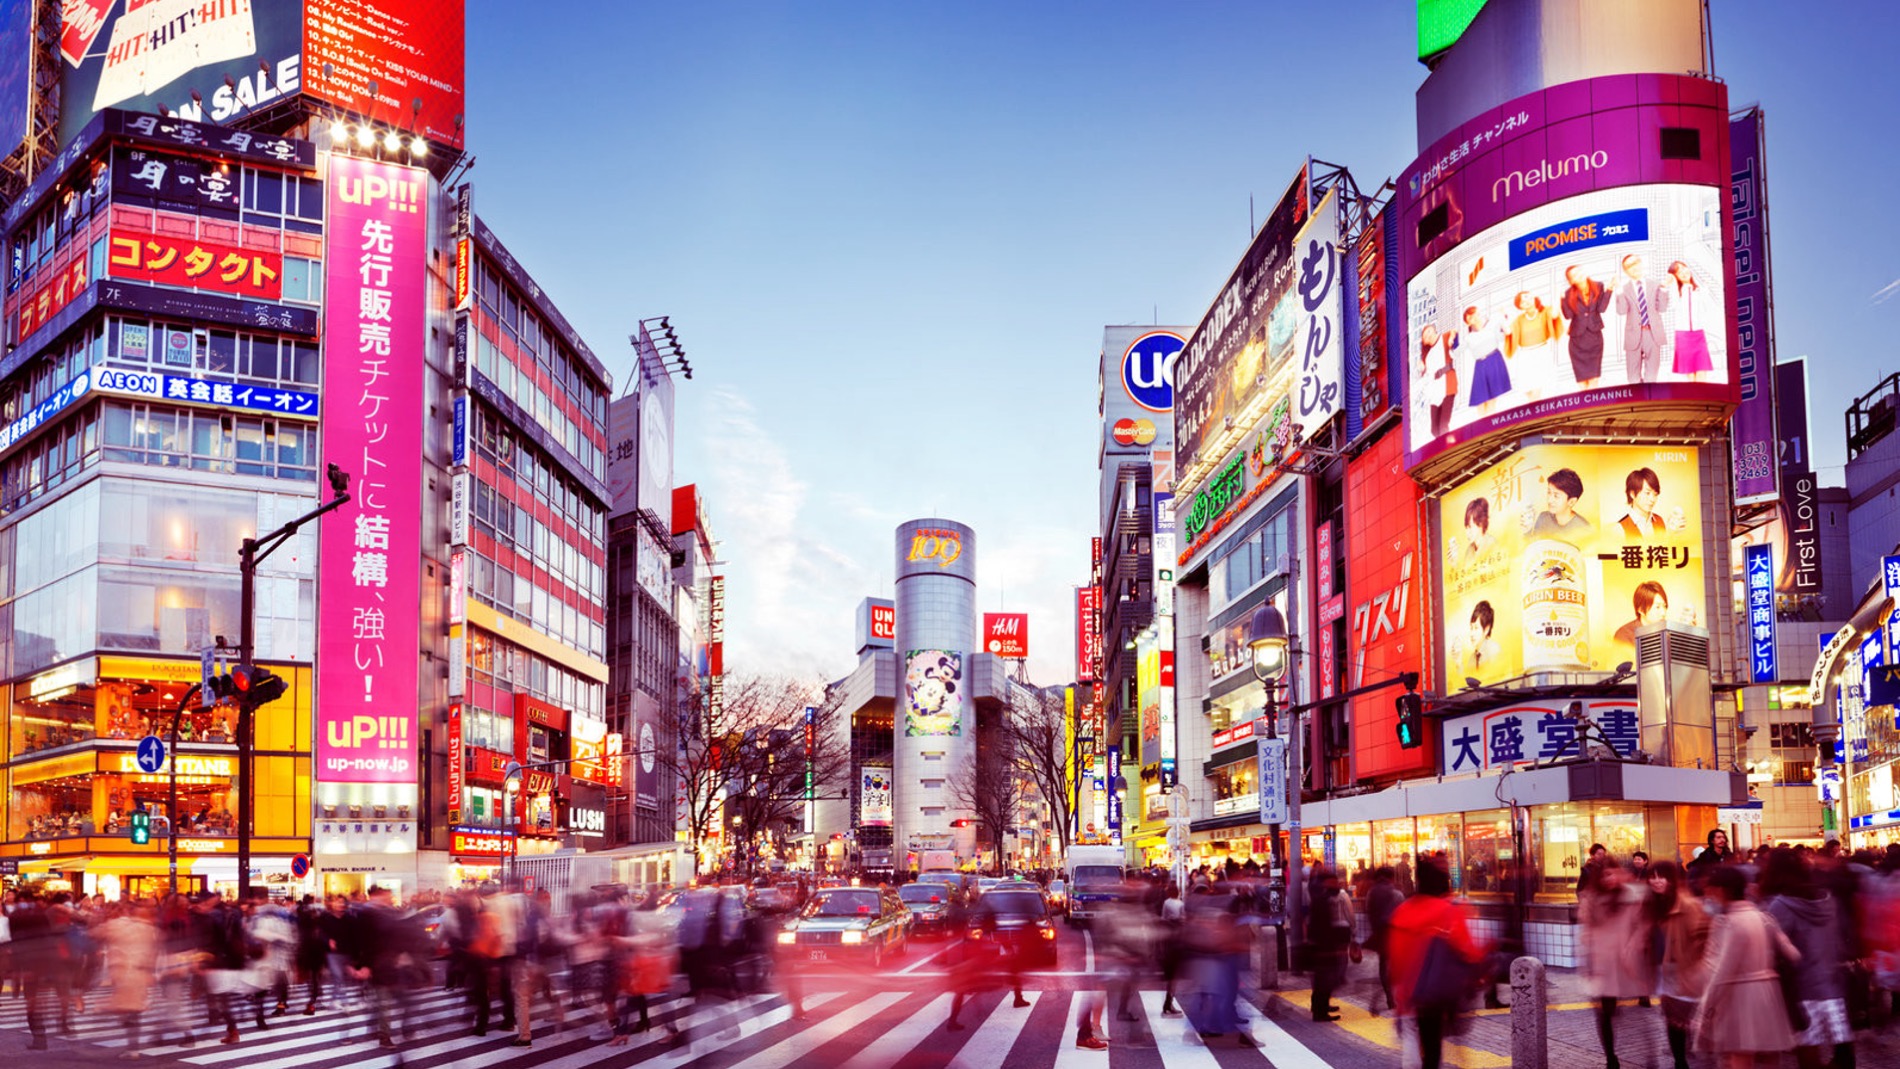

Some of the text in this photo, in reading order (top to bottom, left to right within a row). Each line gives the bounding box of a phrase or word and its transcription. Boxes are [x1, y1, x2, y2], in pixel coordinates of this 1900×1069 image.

[150, 8, 196, 50] HIT!
[108, 32, 148, 68] HIT!
[211, 54, 299, 121] SALE
[386, 60, 404, 74] KISS
[406, 67, 428, 83] YOUR
[430, 78, 452, 93] MIND
[130, 151, 147, 161] 9F
[1422, 111, 1529, 186] わかさ生活 チャンネル
[1492, 150, 1609, 203] melumo
[338, 175, 418, 213] uP!!!
[1526, 223, 1630, 256] PROMISE プロミス
[111, 237, 277, 286] コンタクト
[106, 287, 121, 300] 7F
[1176, 279, 1243, 393] OLDCODEX
[1298, 239, 1337, 416] もんじゃ
[100, 370, 314, 412] AEON 英会話イーオン
[1491, 389, 1634, 426] WAKASA SEIKATSU CHANNEL
[1654, 451, 1688, 463] KIRIN
[1740, 456, 1768, 469] 3719
[1741, 442, 1766, 455] (03)
[1740, 467, 1769, 480] 2468
[1794, 479, 1816, 587] First Love
[907, 534, 962, 567] 109
[1598, 545, 1690, 569] 一番搾り
[1558, 589, 1584, 603] BEER
[875, 609, 892, 621] UN
[1750, 554, 1772, 675] 大盛堂商事ビル
[1080, 591, 1093, 678] Essential
[1536, 627, 1571, 636] 一番搾り
[1003, 645, 1023, 653] 150m
[327, 715, 408, 749] uP!!!
[327, 758, 408, 772] up-now.jp
[1263, 747, 1275, 810] 文化村通り
[569, 807, 604, 830] LUSH
